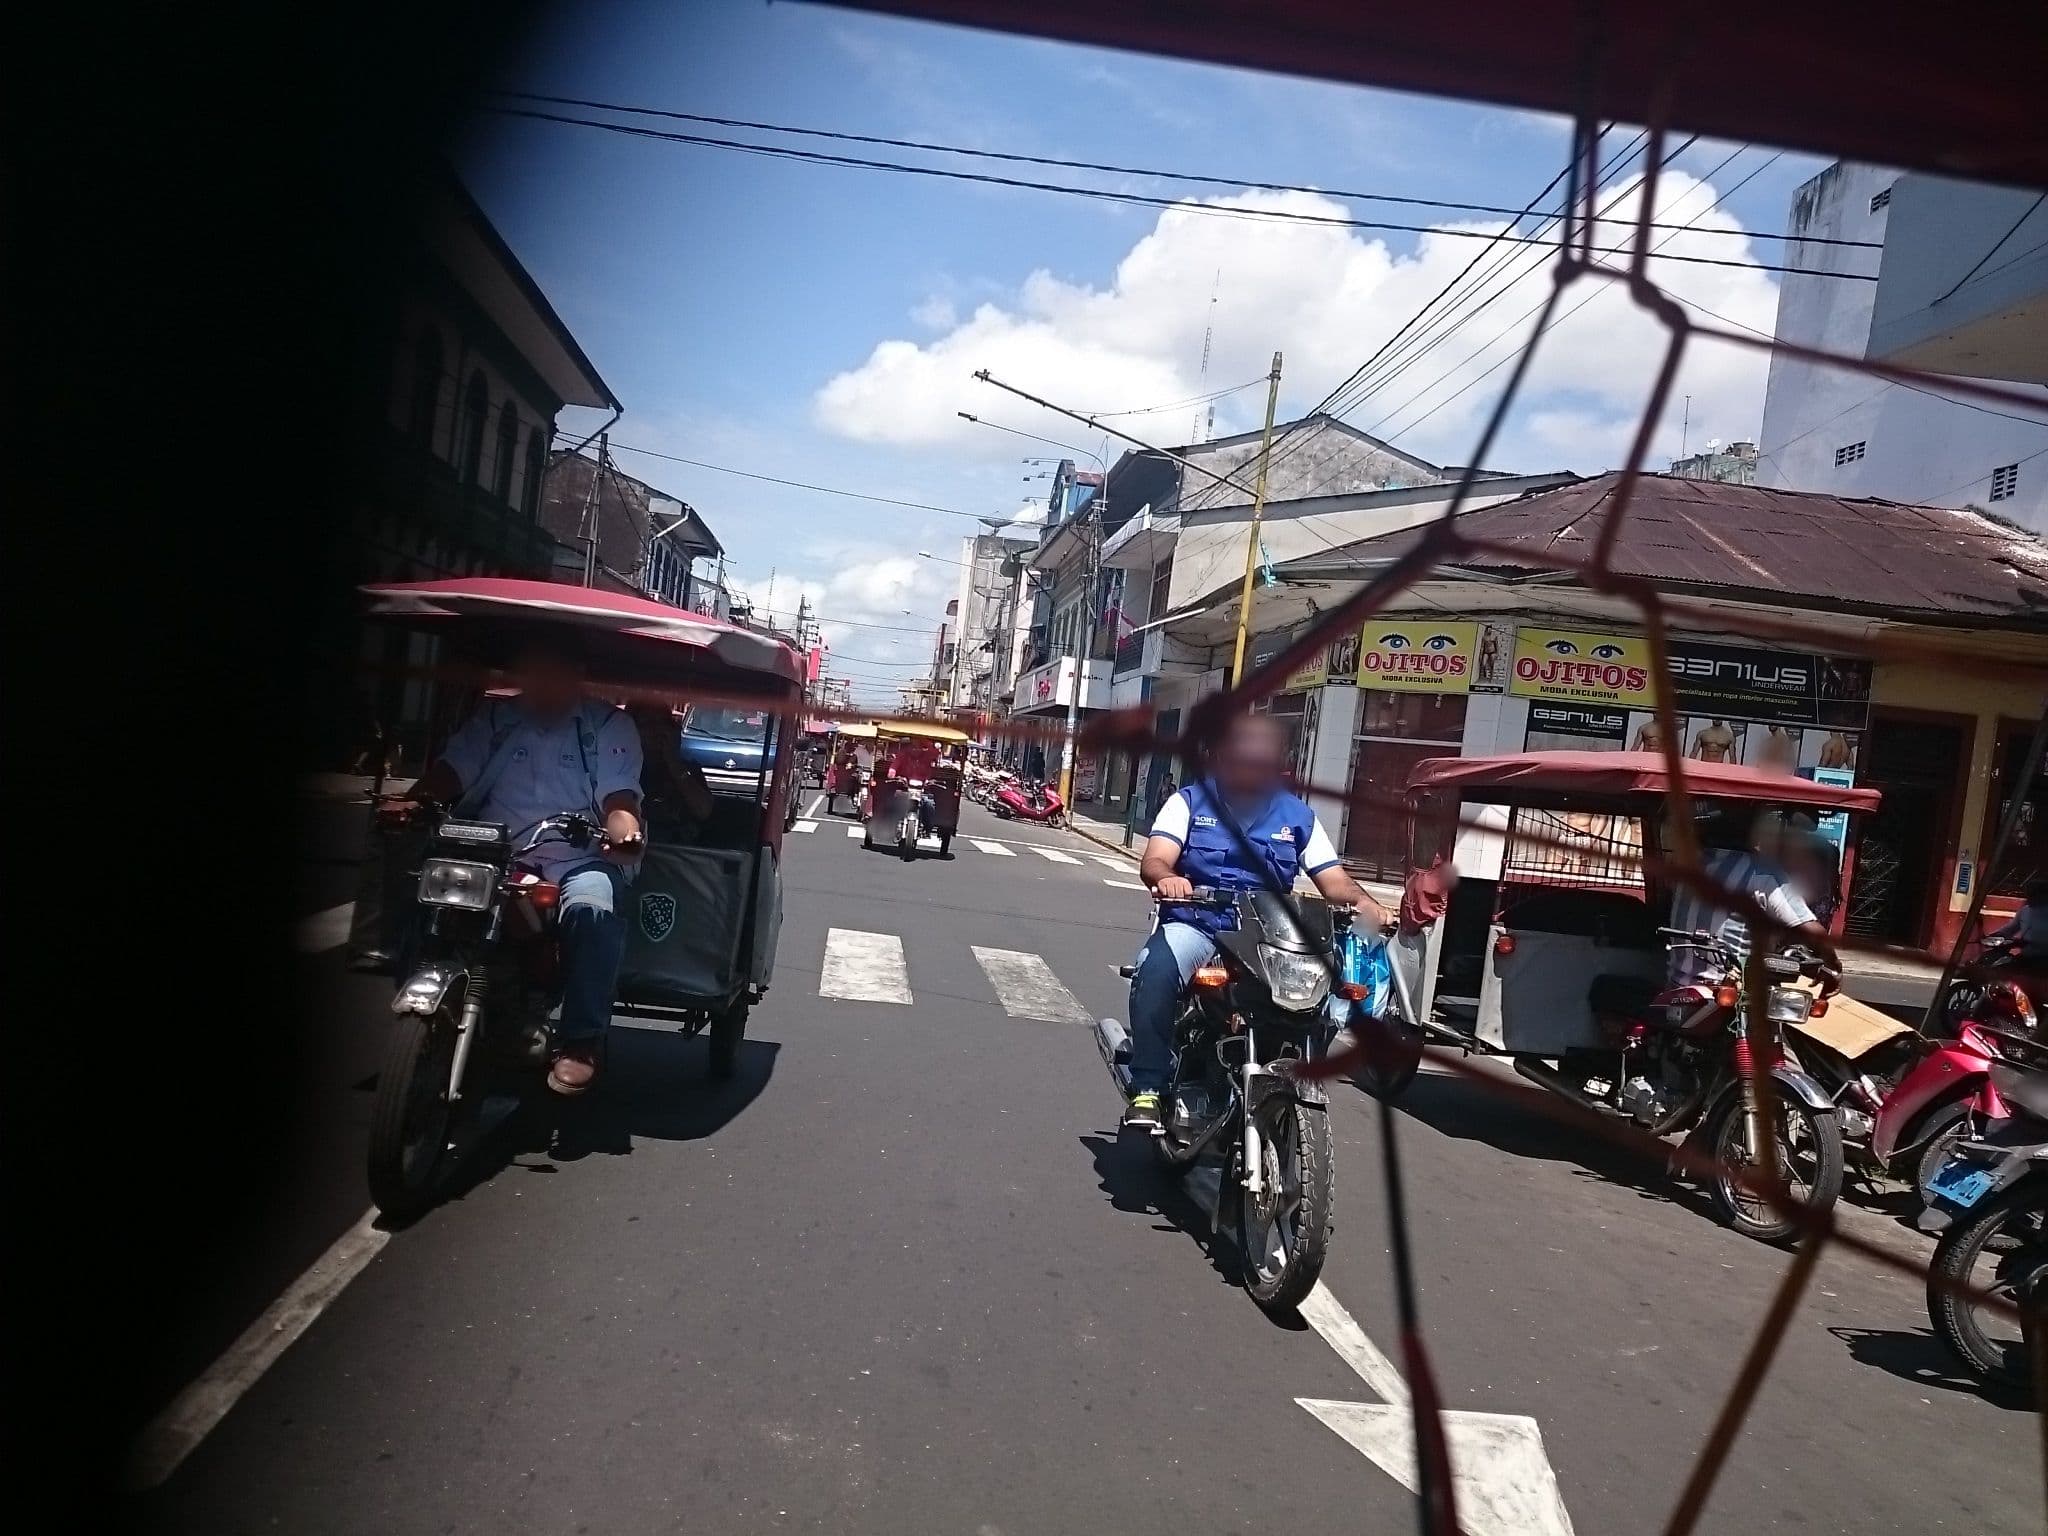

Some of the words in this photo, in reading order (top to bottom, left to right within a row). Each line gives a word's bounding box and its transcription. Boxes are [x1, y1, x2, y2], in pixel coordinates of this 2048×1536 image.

[1364, 651, 1467, 676] OJITOS
[1381, 674, 1403, 683] MODA
[1405, 676, 1443, 685] EXCLUSIVA
[1516, 657, 1648, 692] OJITOS
[1539, 685, 1568, 695] MODA
[1570, 688, 1619, 700] EXCLUSIVA
[1751, 680, 1807, 693] UNDERWEAR
[1673, 687, 1712, 698] specialistas
[1722, 692, 1738, 701] ropa
[1739, 692, 1763, 702] inferior
